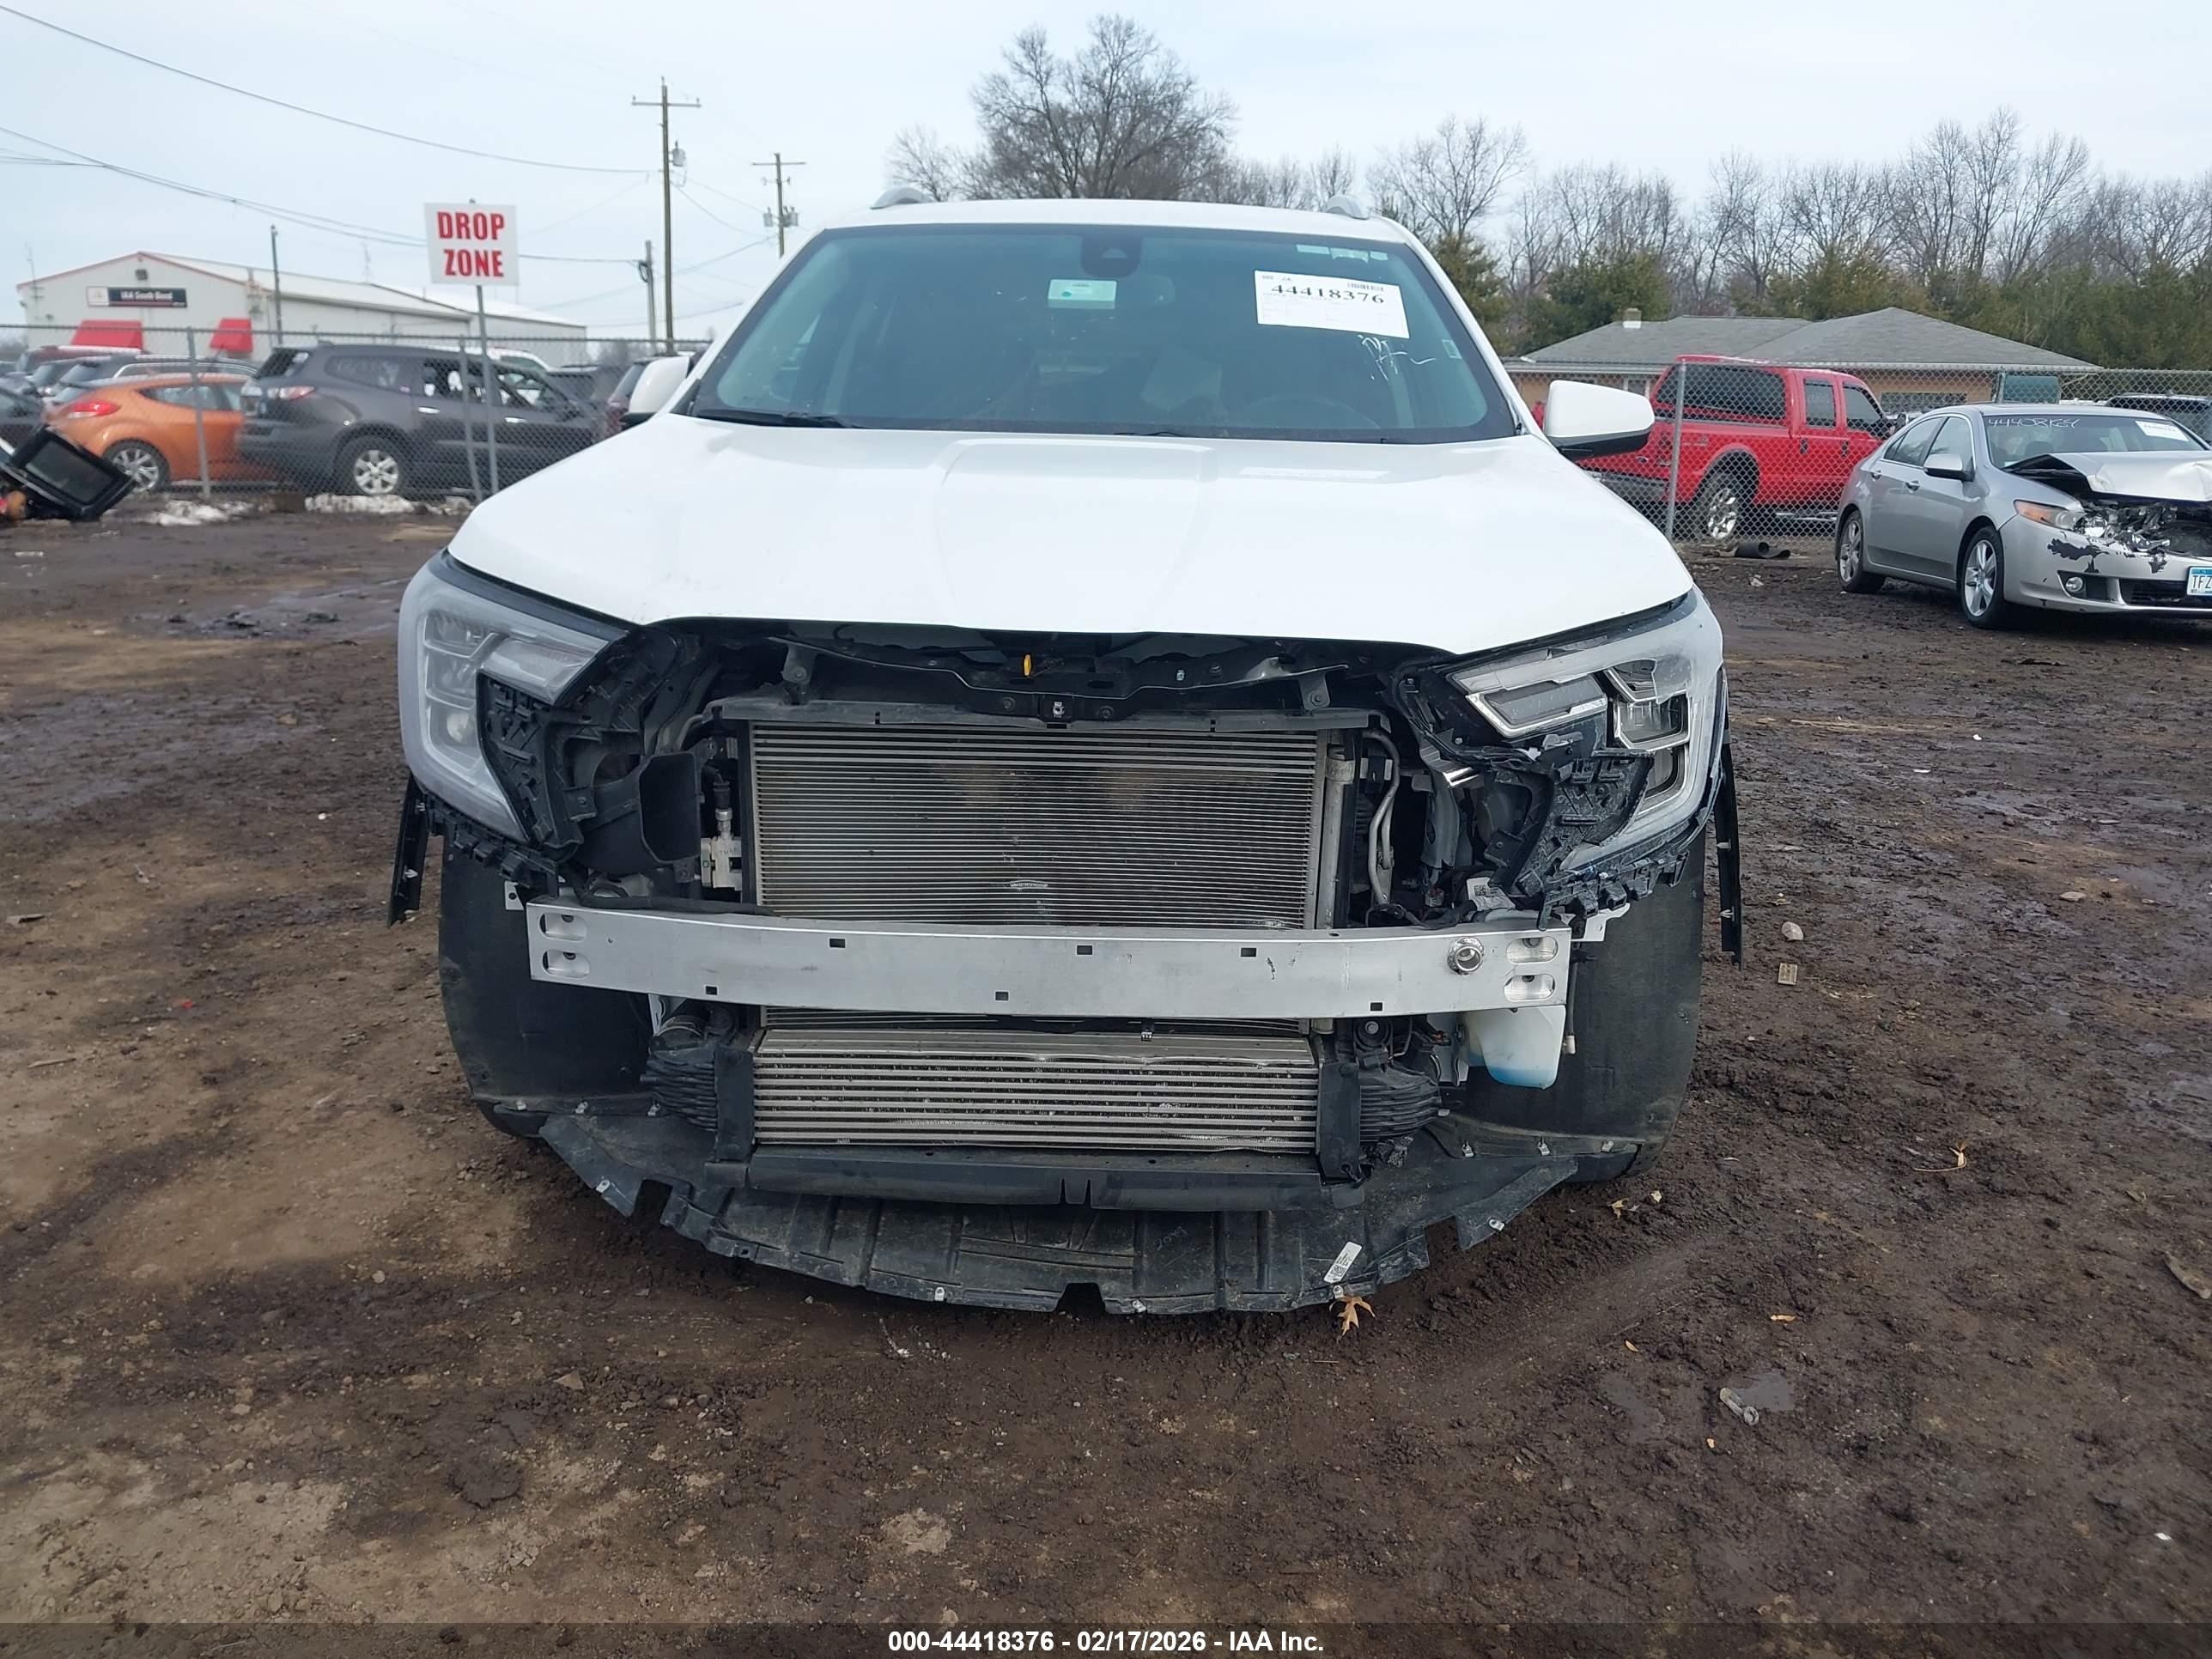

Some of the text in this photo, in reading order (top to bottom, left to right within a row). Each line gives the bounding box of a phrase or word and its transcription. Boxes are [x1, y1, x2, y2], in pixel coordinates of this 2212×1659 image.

[438, 211, 505, 240] DROP
[444, 249, 504, 277] ZONE
[1271, 284, 1385, 304] 44418376
